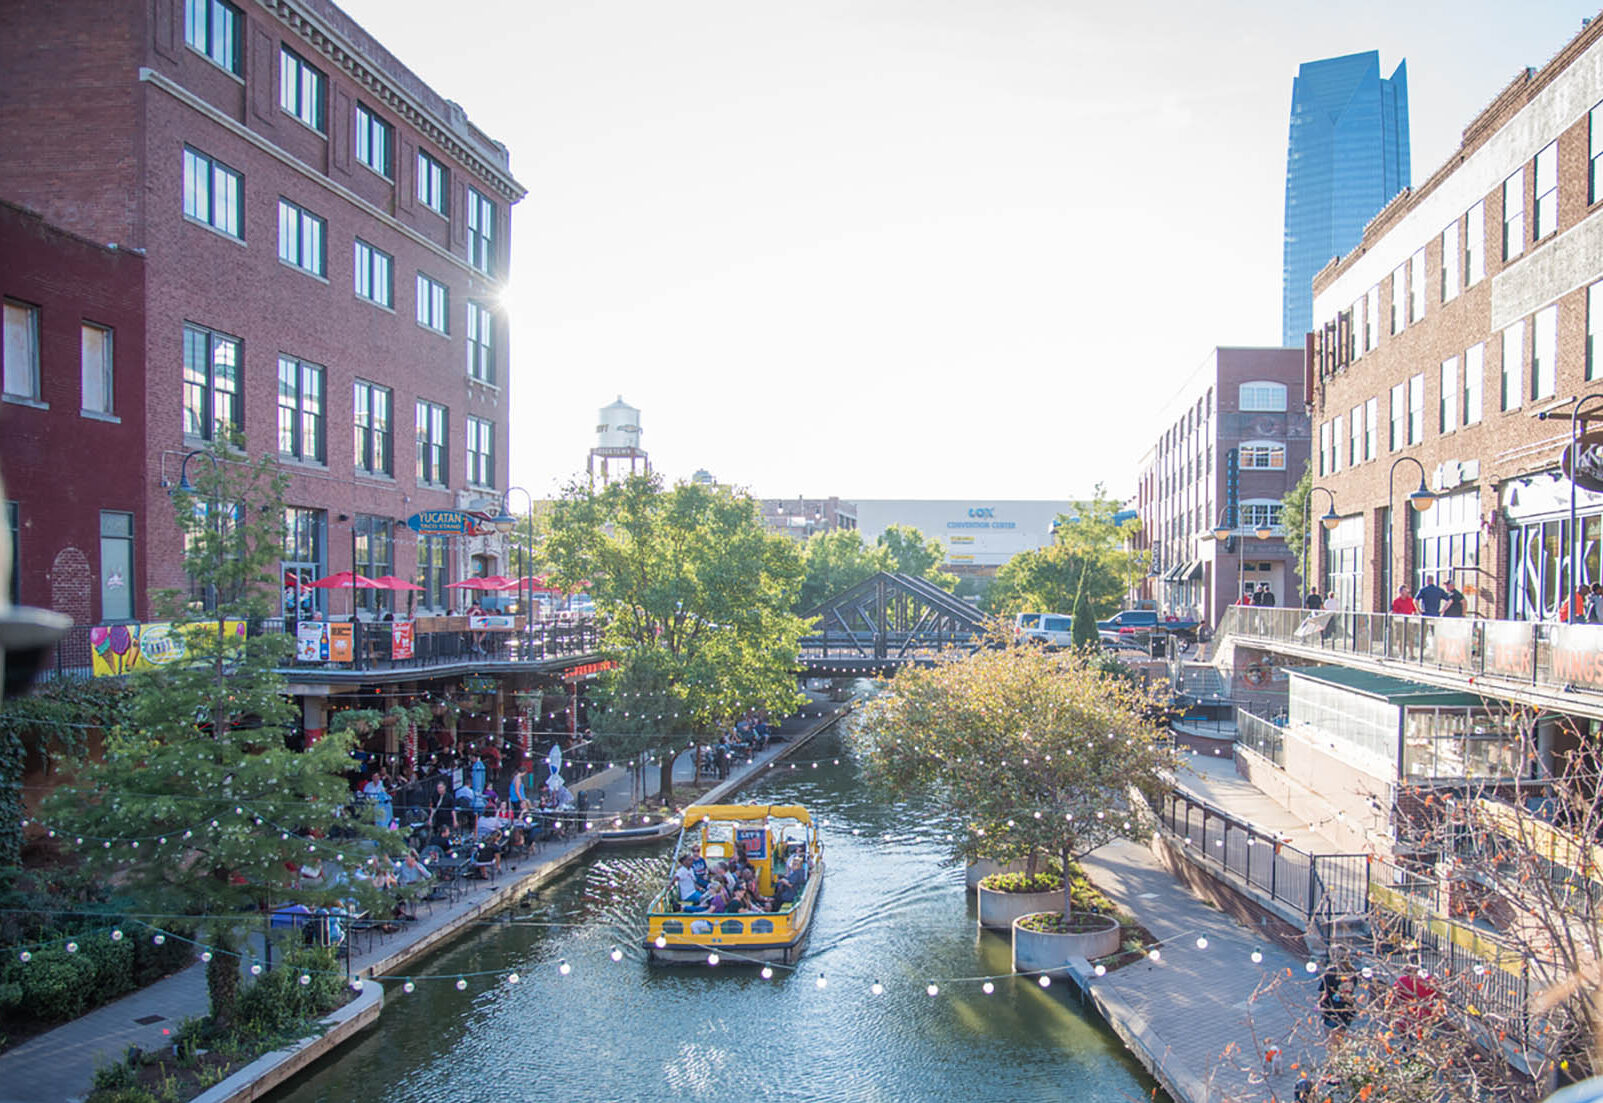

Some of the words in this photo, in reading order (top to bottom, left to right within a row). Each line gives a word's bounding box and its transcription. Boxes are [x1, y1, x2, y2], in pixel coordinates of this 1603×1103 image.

[419, 512, 461, 523] YUCATAN
[968, 507, 995, 518] COX
[1552, 648, 1603, 684] WINGS
